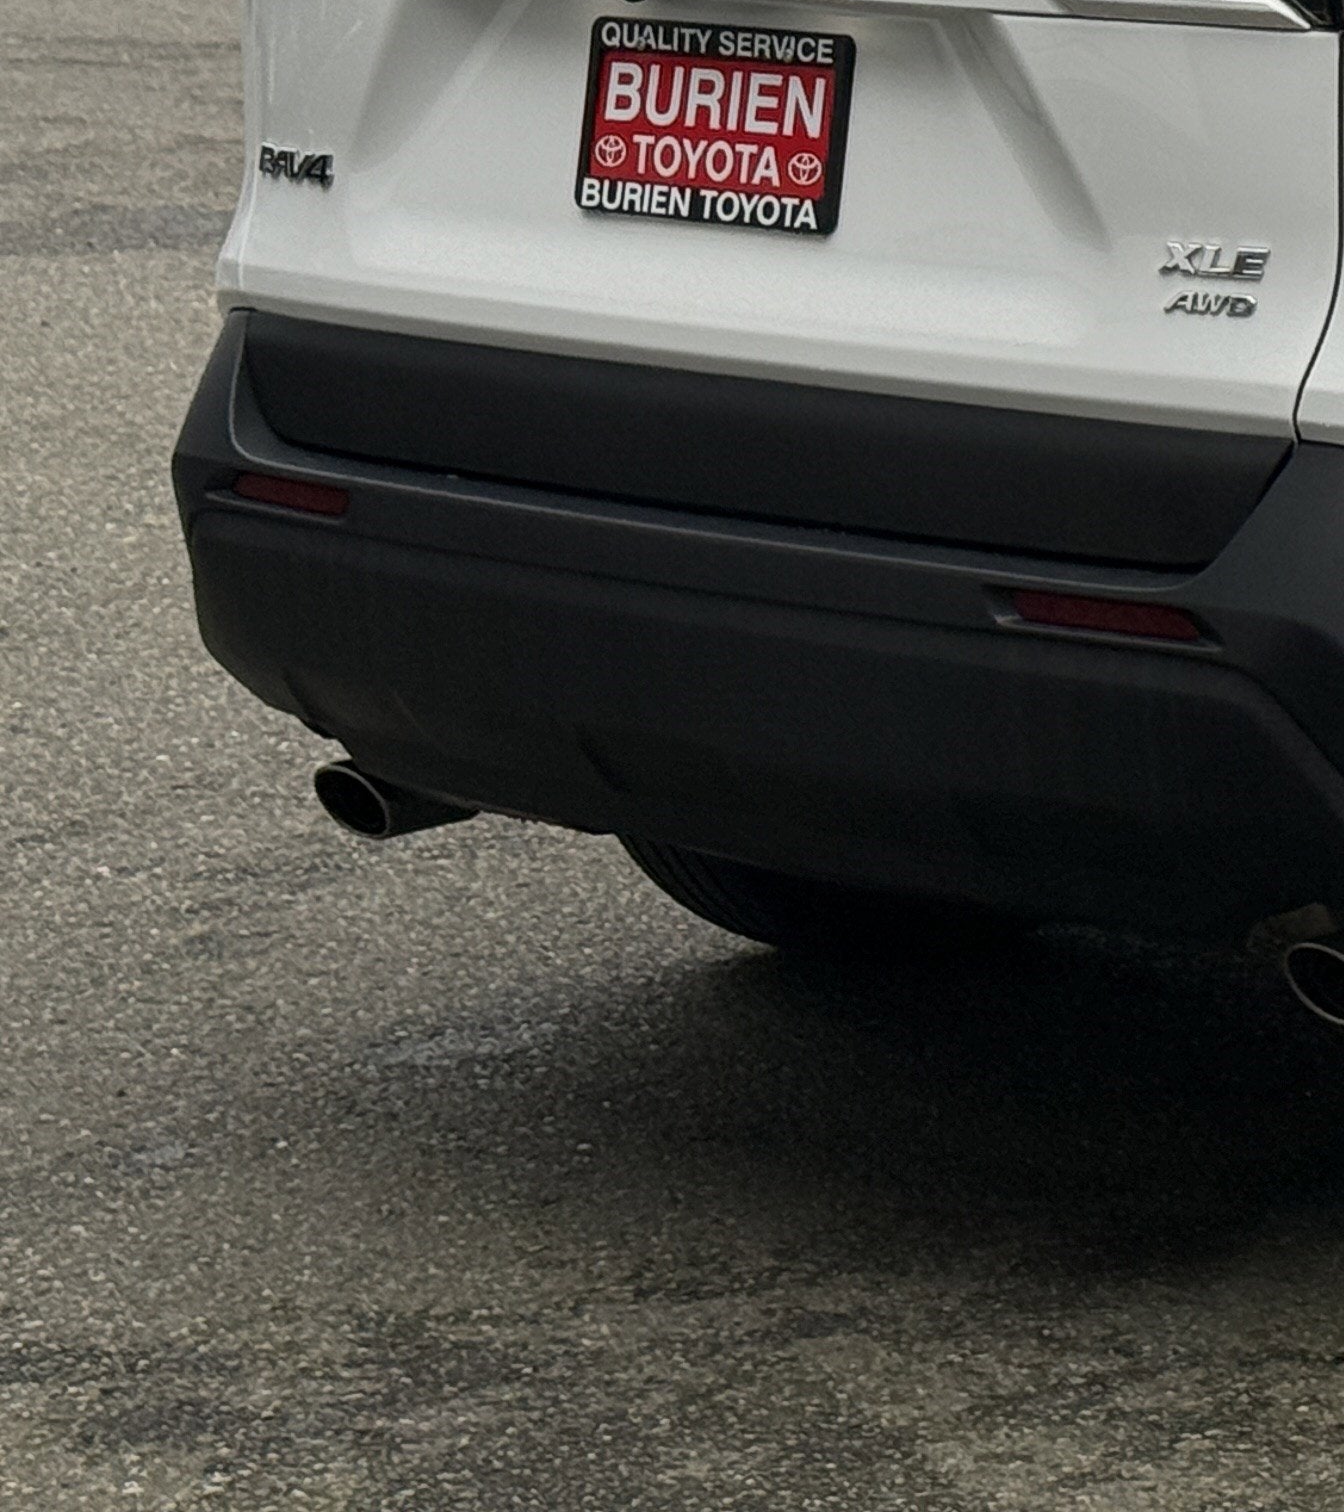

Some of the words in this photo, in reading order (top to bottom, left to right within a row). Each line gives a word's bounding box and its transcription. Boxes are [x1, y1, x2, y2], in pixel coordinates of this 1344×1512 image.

[601, 21, 713, 56] QUALITY
[718, 31, 835, 64] SERVICE
[603, 61, 827, 139] BURIEN
[632, 134, 781, 188] TOYOTA
[580, 177, 692, 218] BURIEN
[699, 188, 818, 231] TOYOTA
[1158, 241, 1271, 281] XLE
[1163, 290, 1258, 318] AWD
